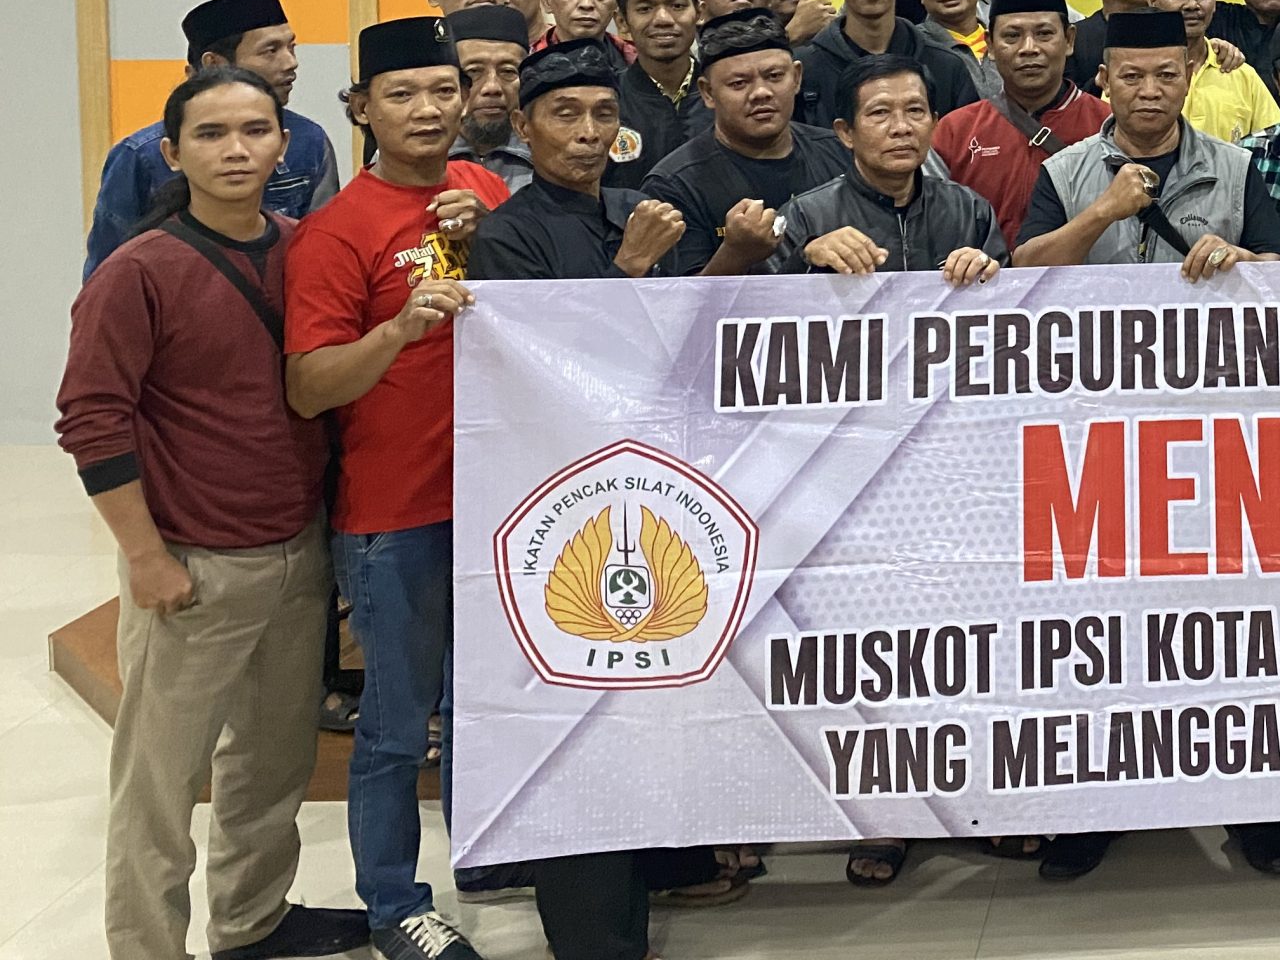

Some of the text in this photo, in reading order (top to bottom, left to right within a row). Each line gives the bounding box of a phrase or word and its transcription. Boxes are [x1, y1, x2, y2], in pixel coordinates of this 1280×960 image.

[720, 318, 883, 408] KAMI
[523, 476, 730, 576] IKATAN PENCAK SILAT INDONESIA
[586, 648, 670, 669] IPSI
[770, 623, 998, 706] MUSKOT
[1021, 614, 1122, 690] IPSI
[1147, 610, 1279, 683] KOTA
[825, 724, 968, 796] YANG
